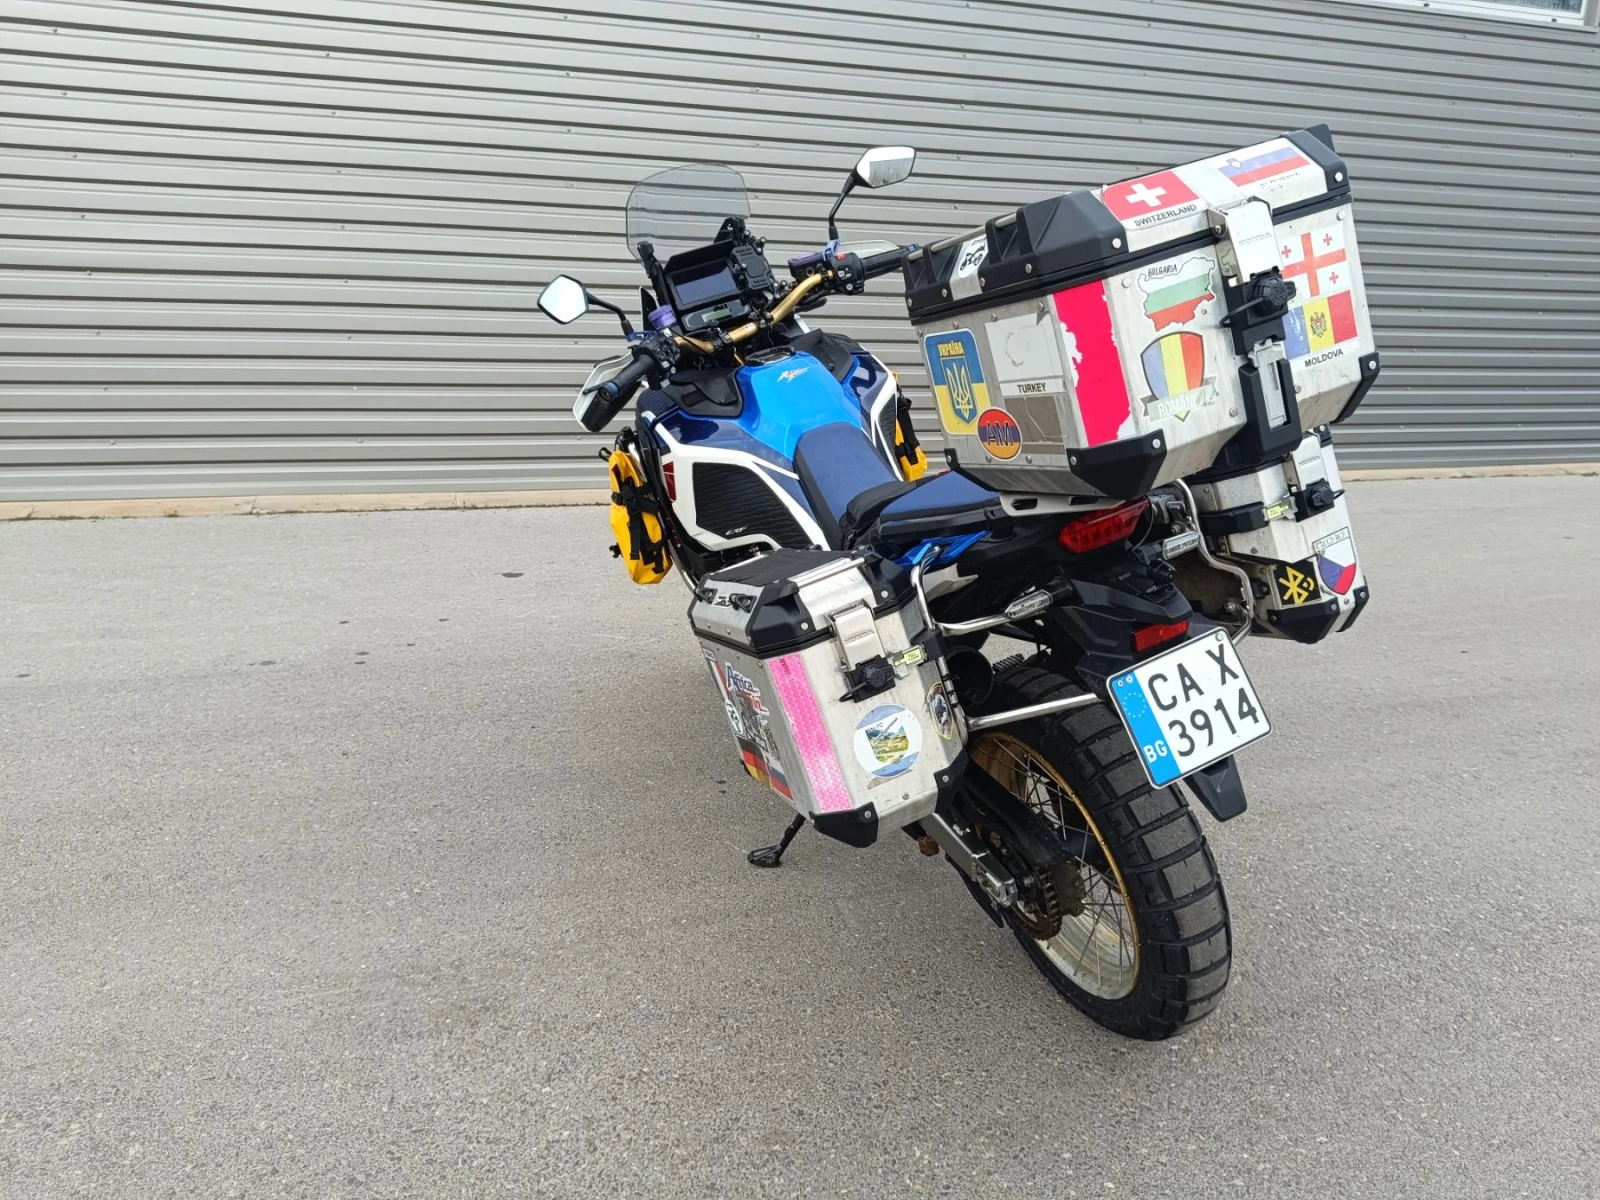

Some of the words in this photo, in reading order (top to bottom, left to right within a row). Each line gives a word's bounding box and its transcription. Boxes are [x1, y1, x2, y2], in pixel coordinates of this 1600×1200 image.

[1134, 203, 1197, 227] SWITZERLAND
[1148, 263, 1178, 277] BULGARIA
[937, 340, 965, 357] УКРАЇНА
[1304, 348, 1344, 368] MOLDOVA
[1017, 382, 1046, 394] TURKEY
[986, 420, 1014, 447] AM
[1147, 662, 1205, 712] CA
[1204, 643, 1240, 686] X
[1168, 687, 1260, 757] 3914
[1143, 739, 1168, 763] BG
